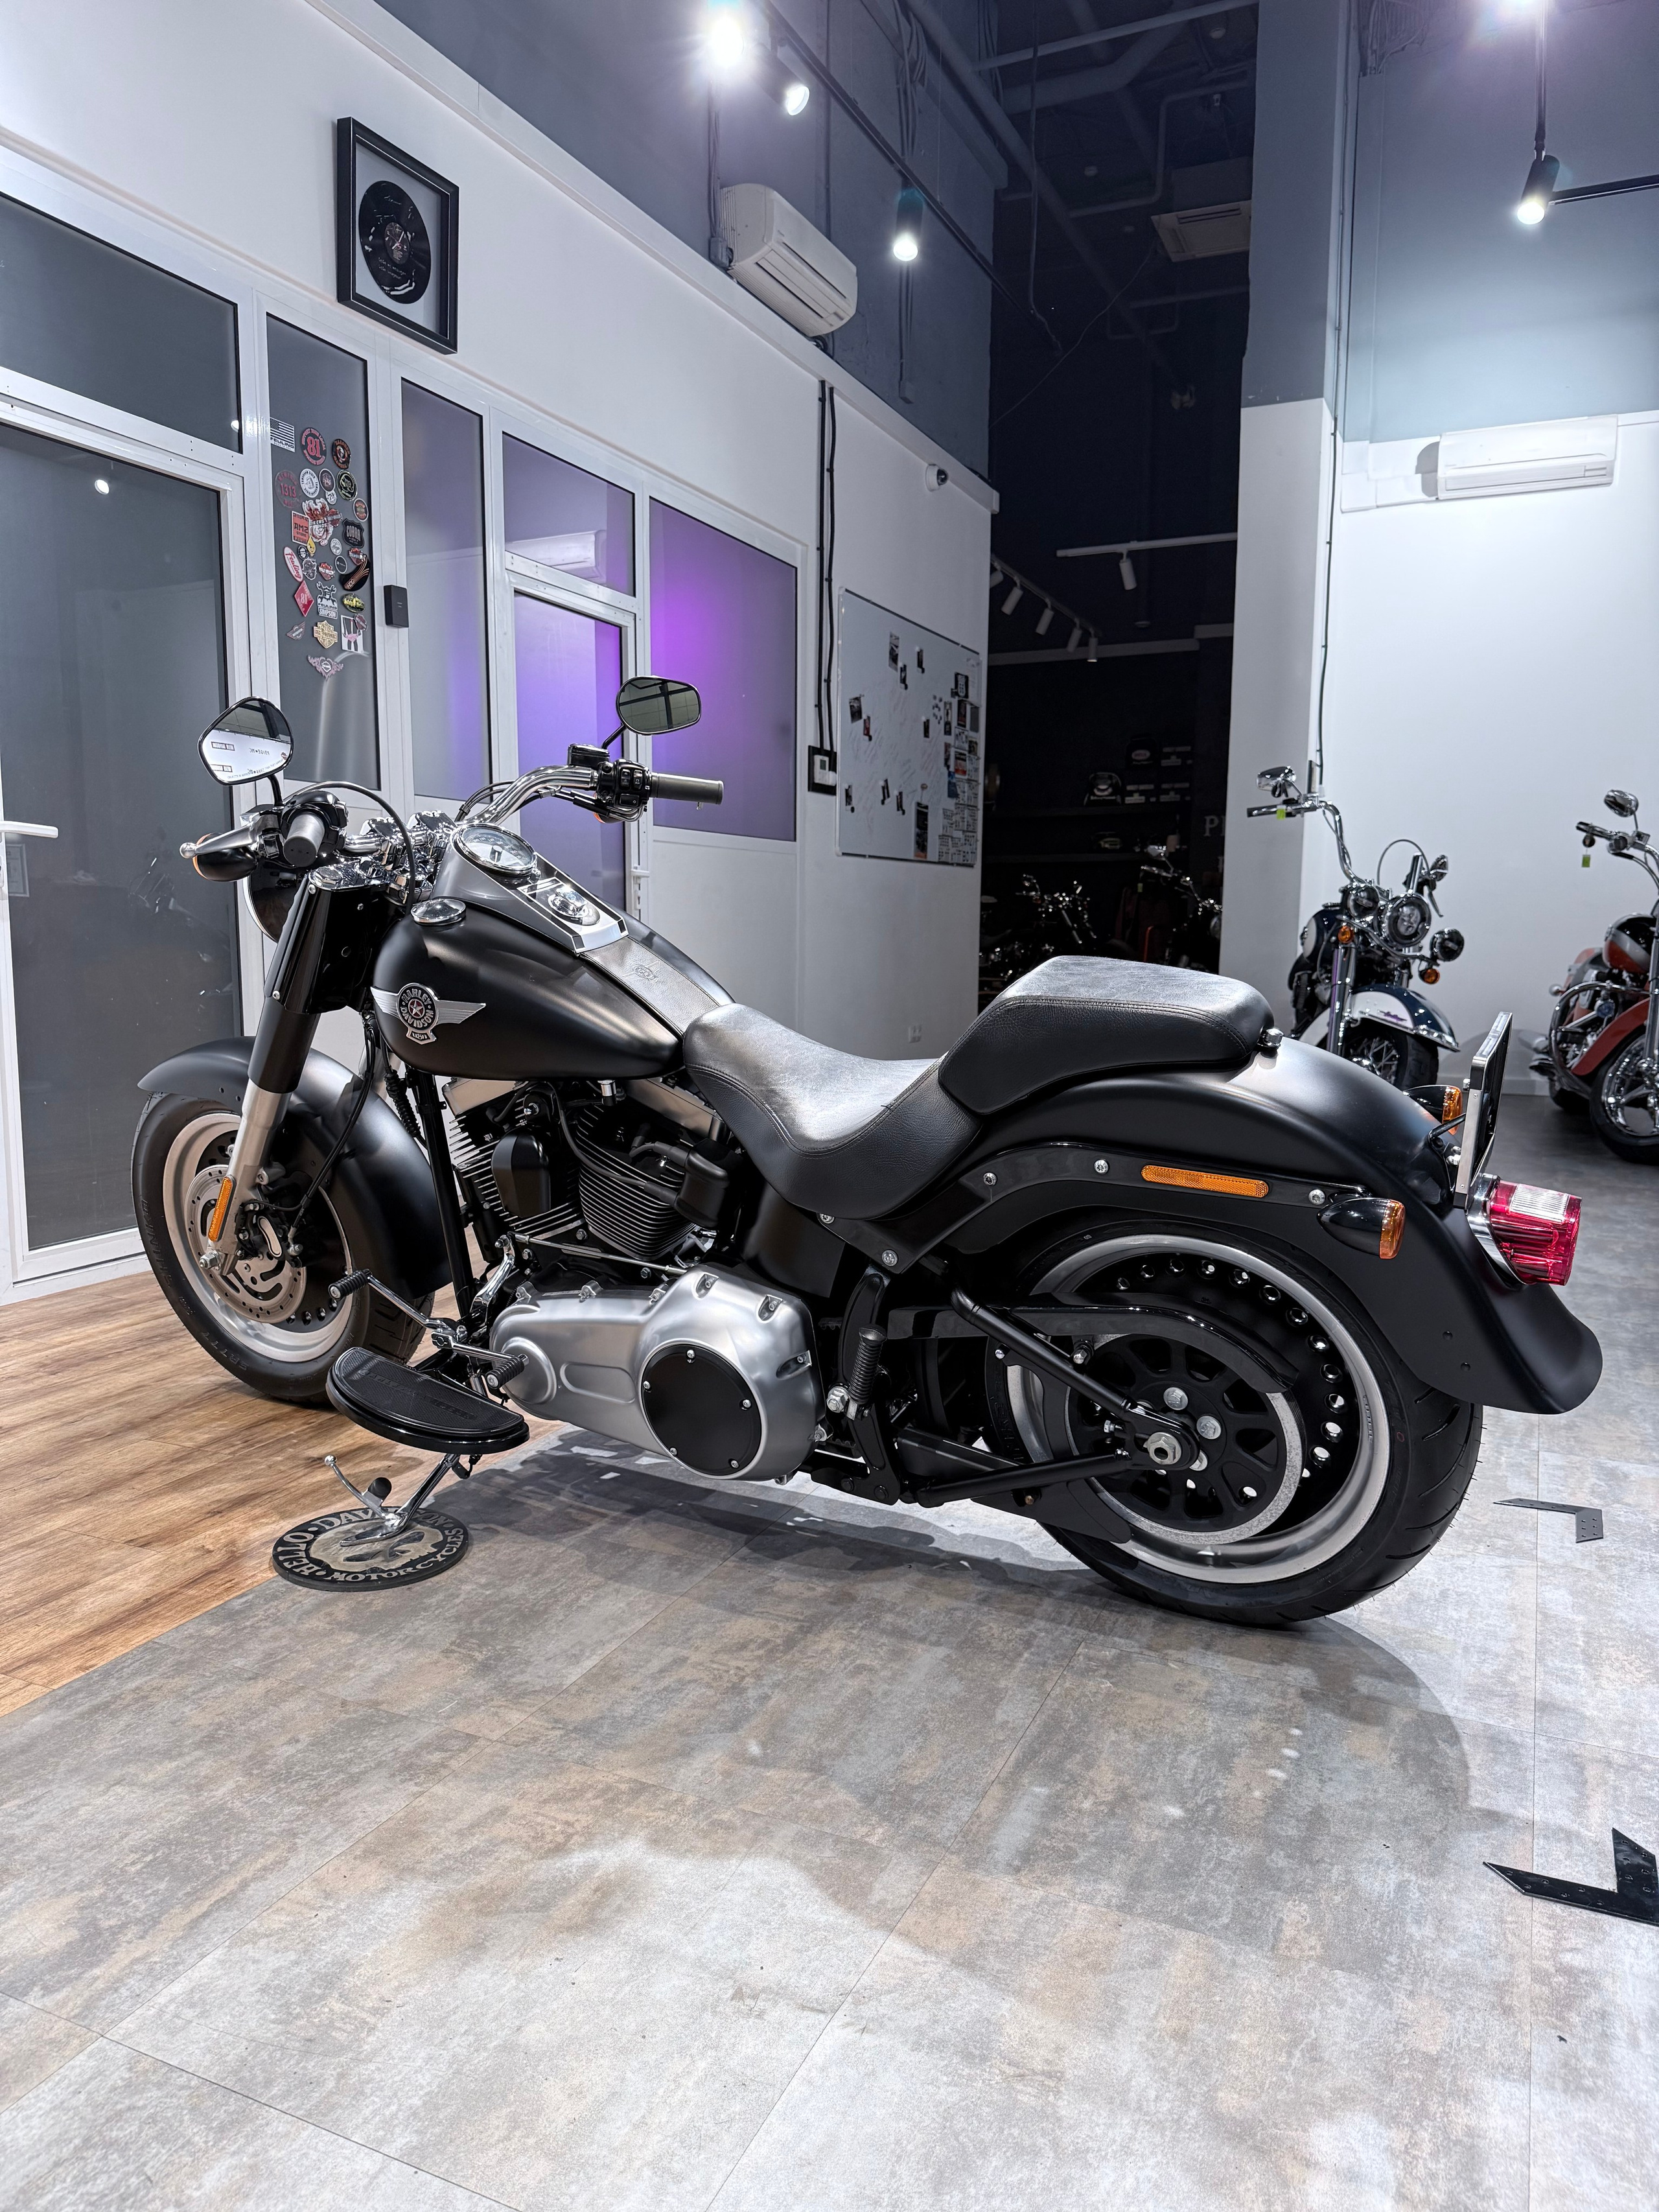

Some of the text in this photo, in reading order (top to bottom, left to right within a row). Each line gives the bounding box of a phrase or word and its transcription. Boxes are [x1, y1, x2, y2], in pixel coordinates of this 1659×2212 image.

[307, 436, 321, 458] 81
[280, 483, 296, 498] 1313
[285, 551, 301, 579] Feuling
[300, 592, 308, 605] 81
[319, 608, 336, 618] SIMPSON
[402, 988, 432, 1005] HARLEY
[400, 1006, 434, 1028] DAVIDSON
[277, 1509, 449, 1576] HELLO DAVSON
[323, 1527, 464, 1581] MOTORCYCLES
